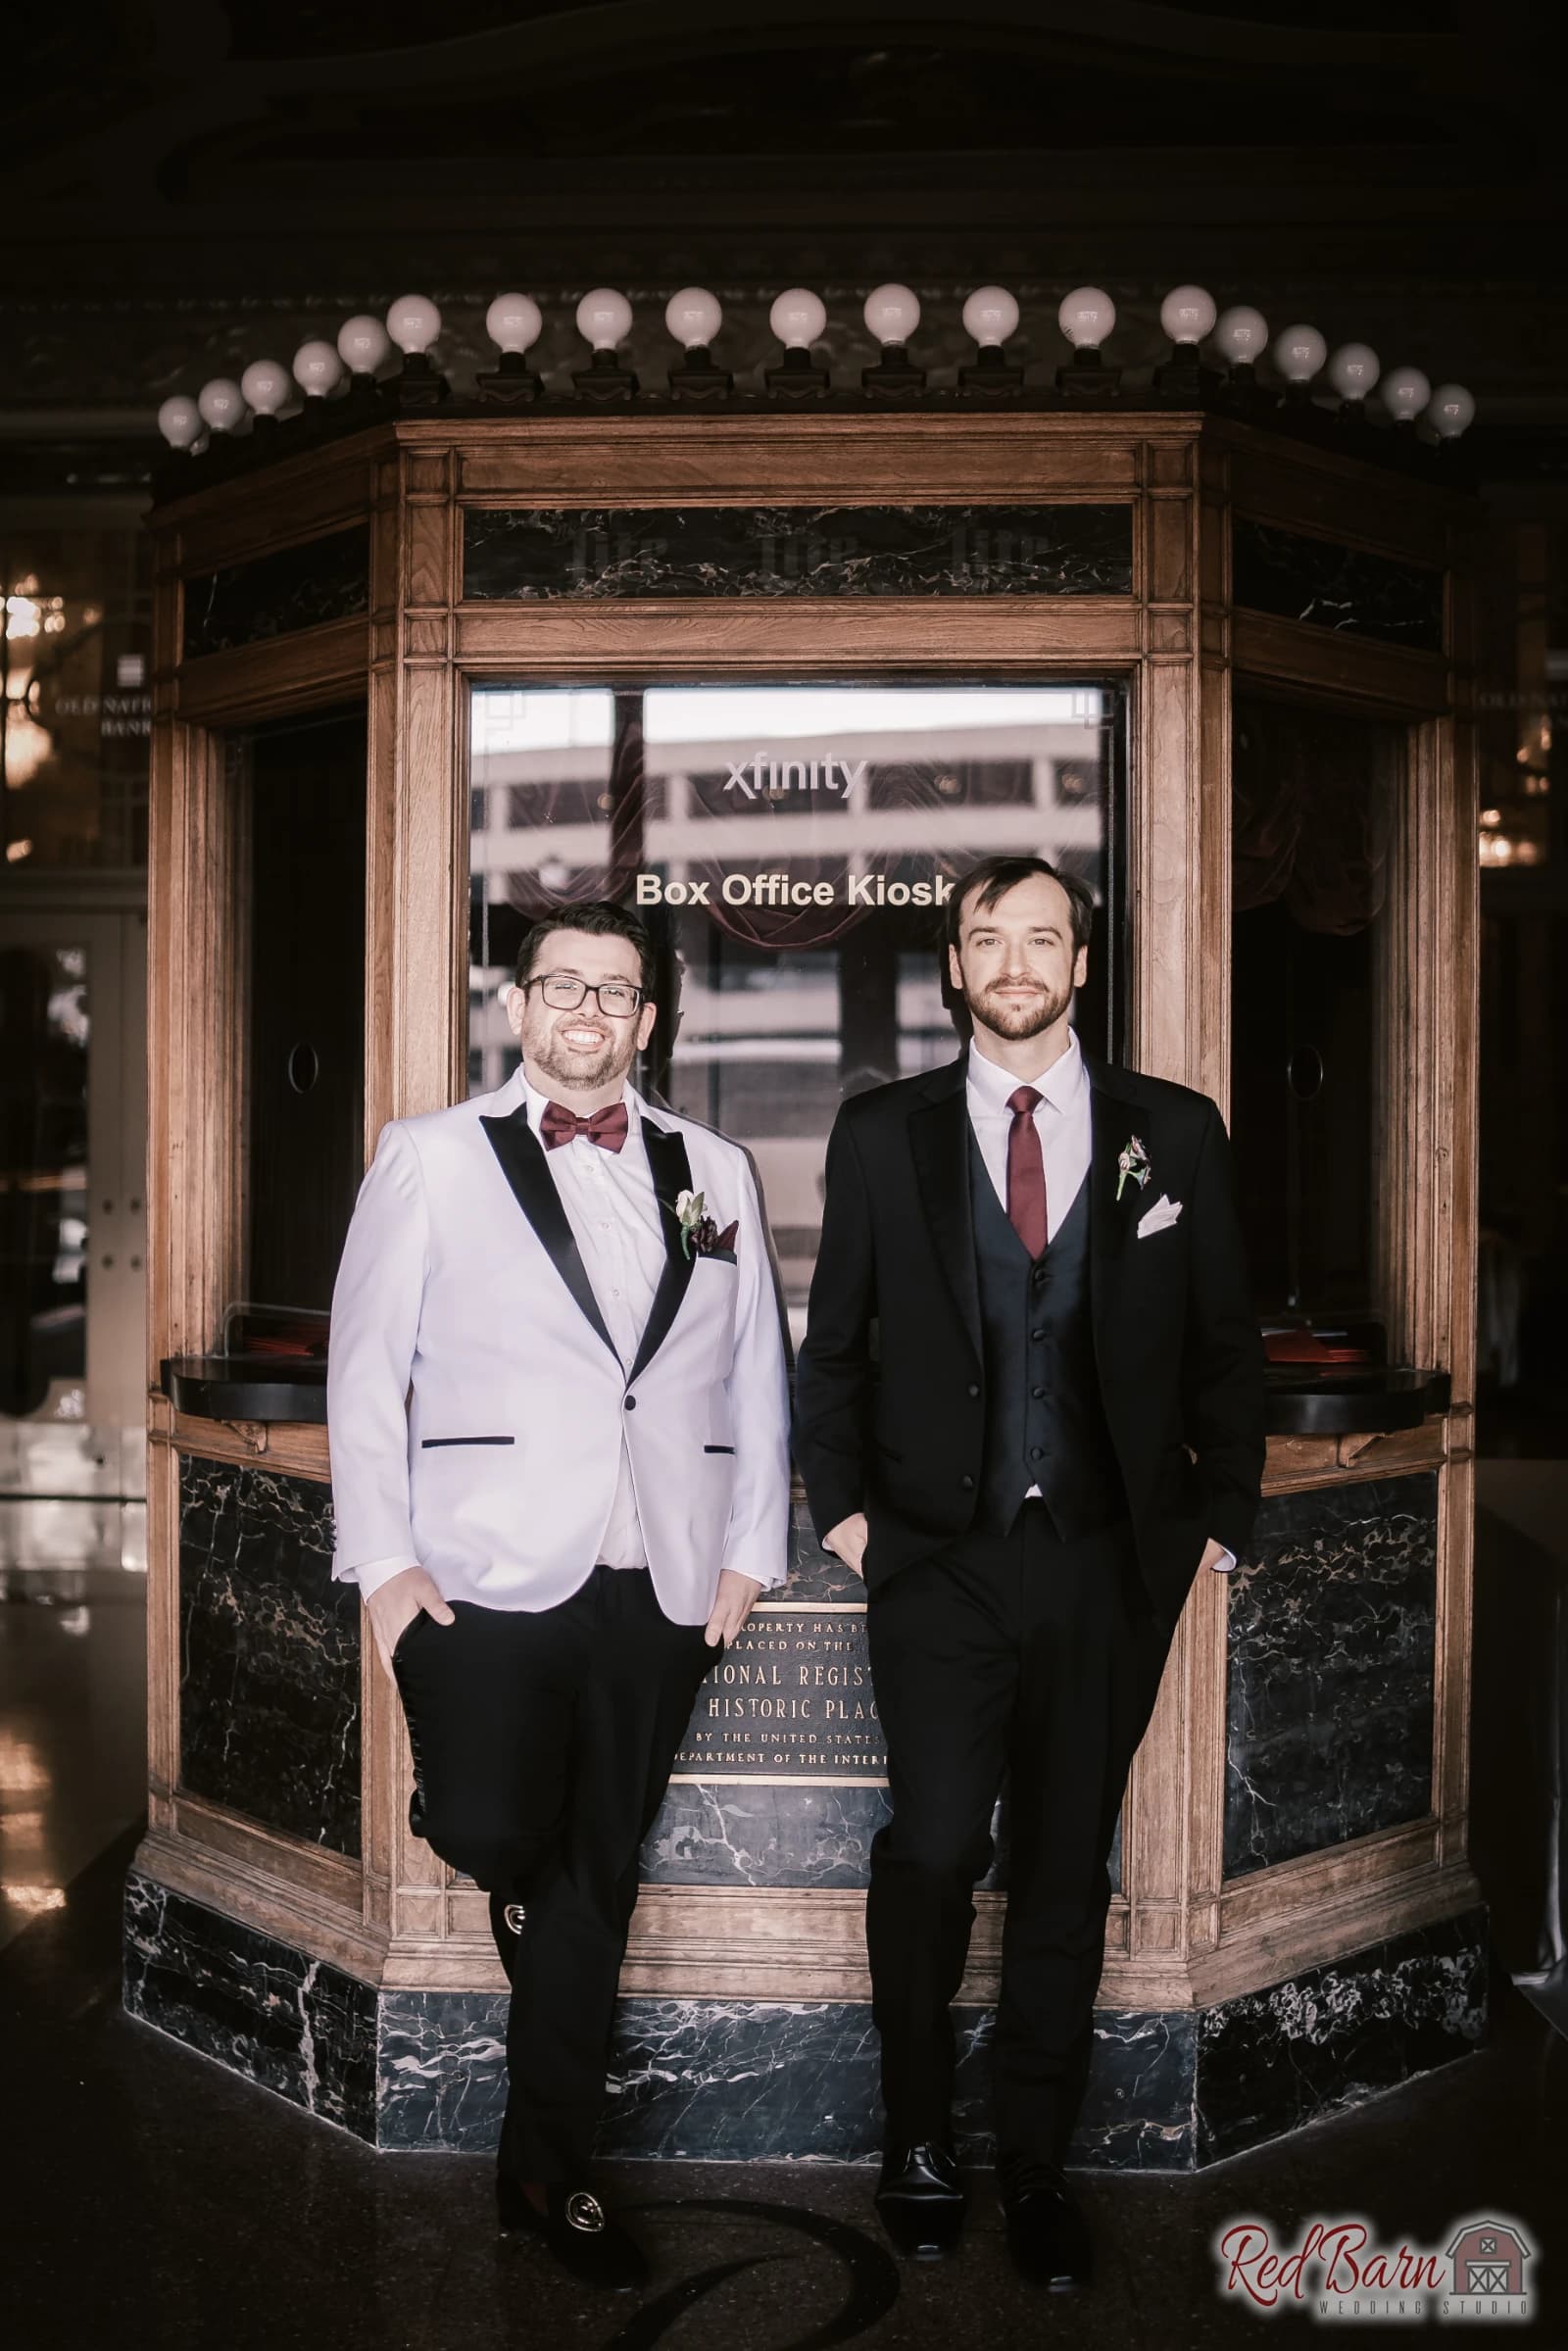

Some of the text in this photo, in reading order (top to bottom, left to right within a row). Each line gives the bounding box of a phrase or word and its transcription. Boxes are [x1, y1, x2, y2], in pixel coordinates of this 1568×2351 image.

[723, 752, 868, 799] xfinity
[636, 873, 956, 906] Box Office Kiosk
[813, 1623, 844, 1633] HAS
[796, 1641, 816, 1650] ON
[823, 1641, 853, 1651] THE
[702, 1665, 781, 1685] IONAL
[709, 1697, 810, 1718] HISTORIC
[696, 1733, 880, 1744] BY THE UNITED STATES
[773, 1754, 791, 1763] OF
[799, 1754, 827, 1764] THE
